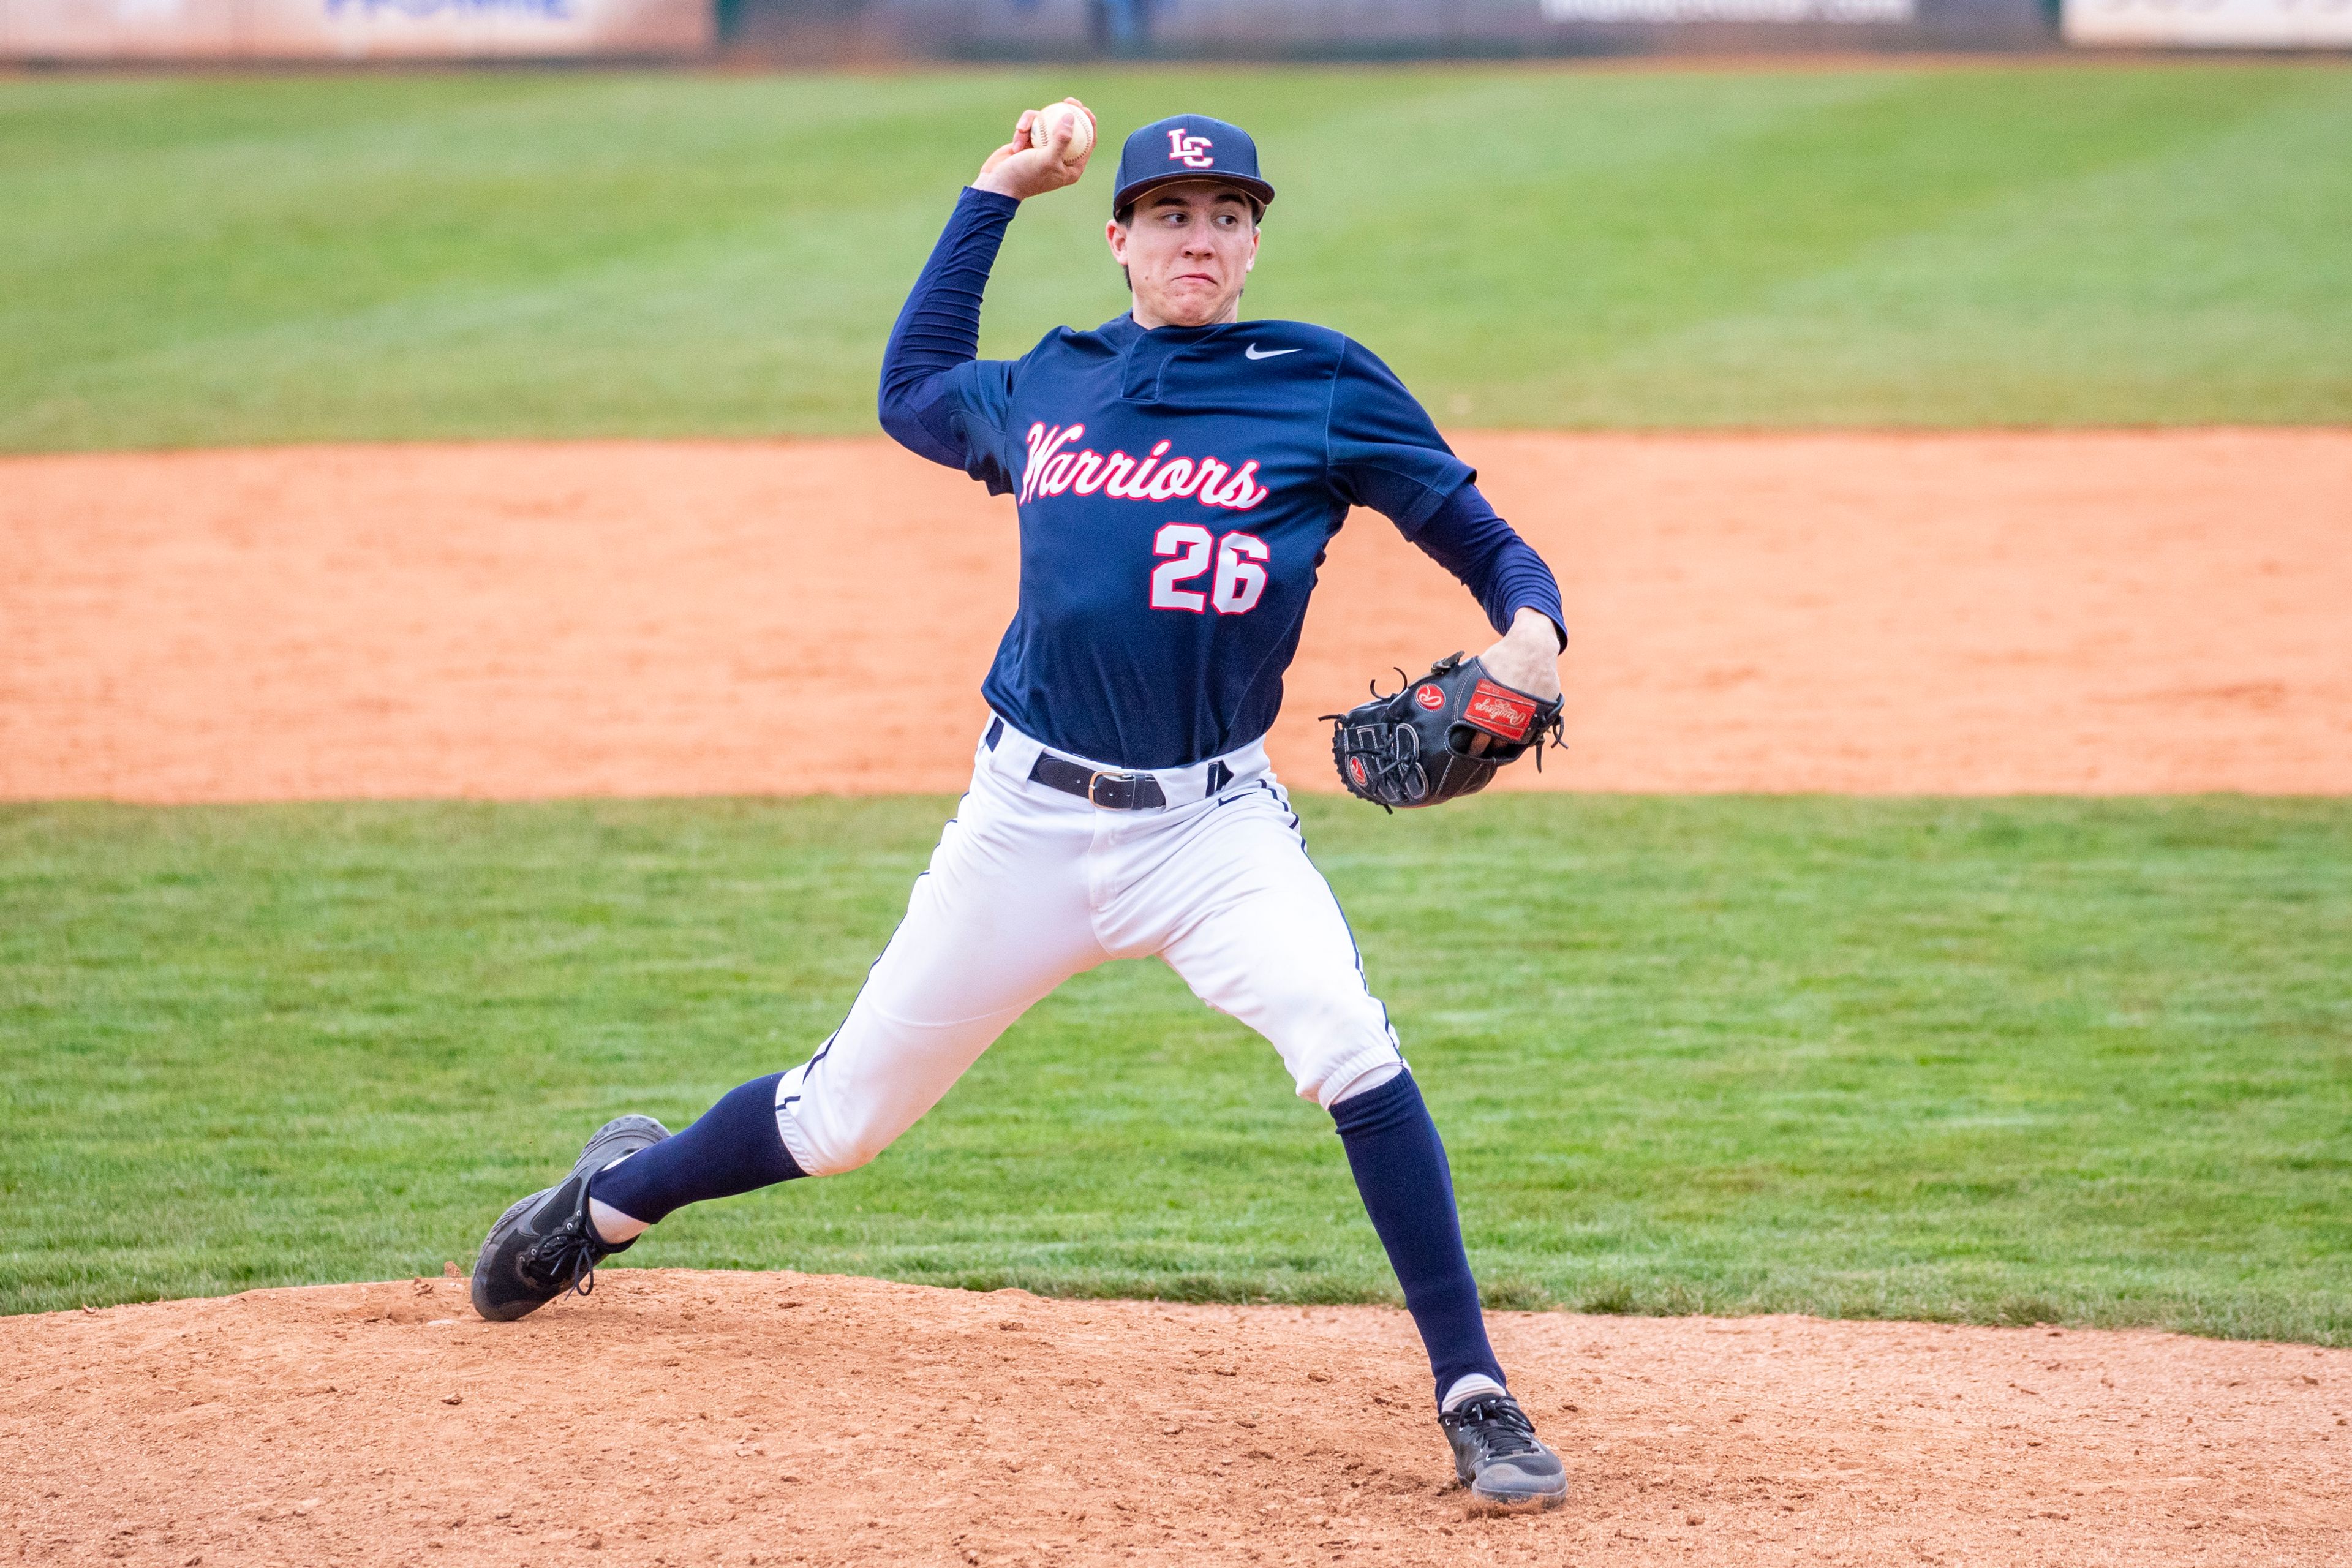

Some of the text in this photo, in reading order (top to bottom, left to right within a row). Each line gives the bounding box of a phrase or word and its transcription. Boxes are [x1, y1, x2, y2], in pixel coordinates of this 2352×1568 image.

[1167, 127, 1214, 168] LC
[1020, 422, 1269, 510] Warriors
[1150, 522, 1270, 615] 26
[1474, 698, 1526, 725] Rawlings
